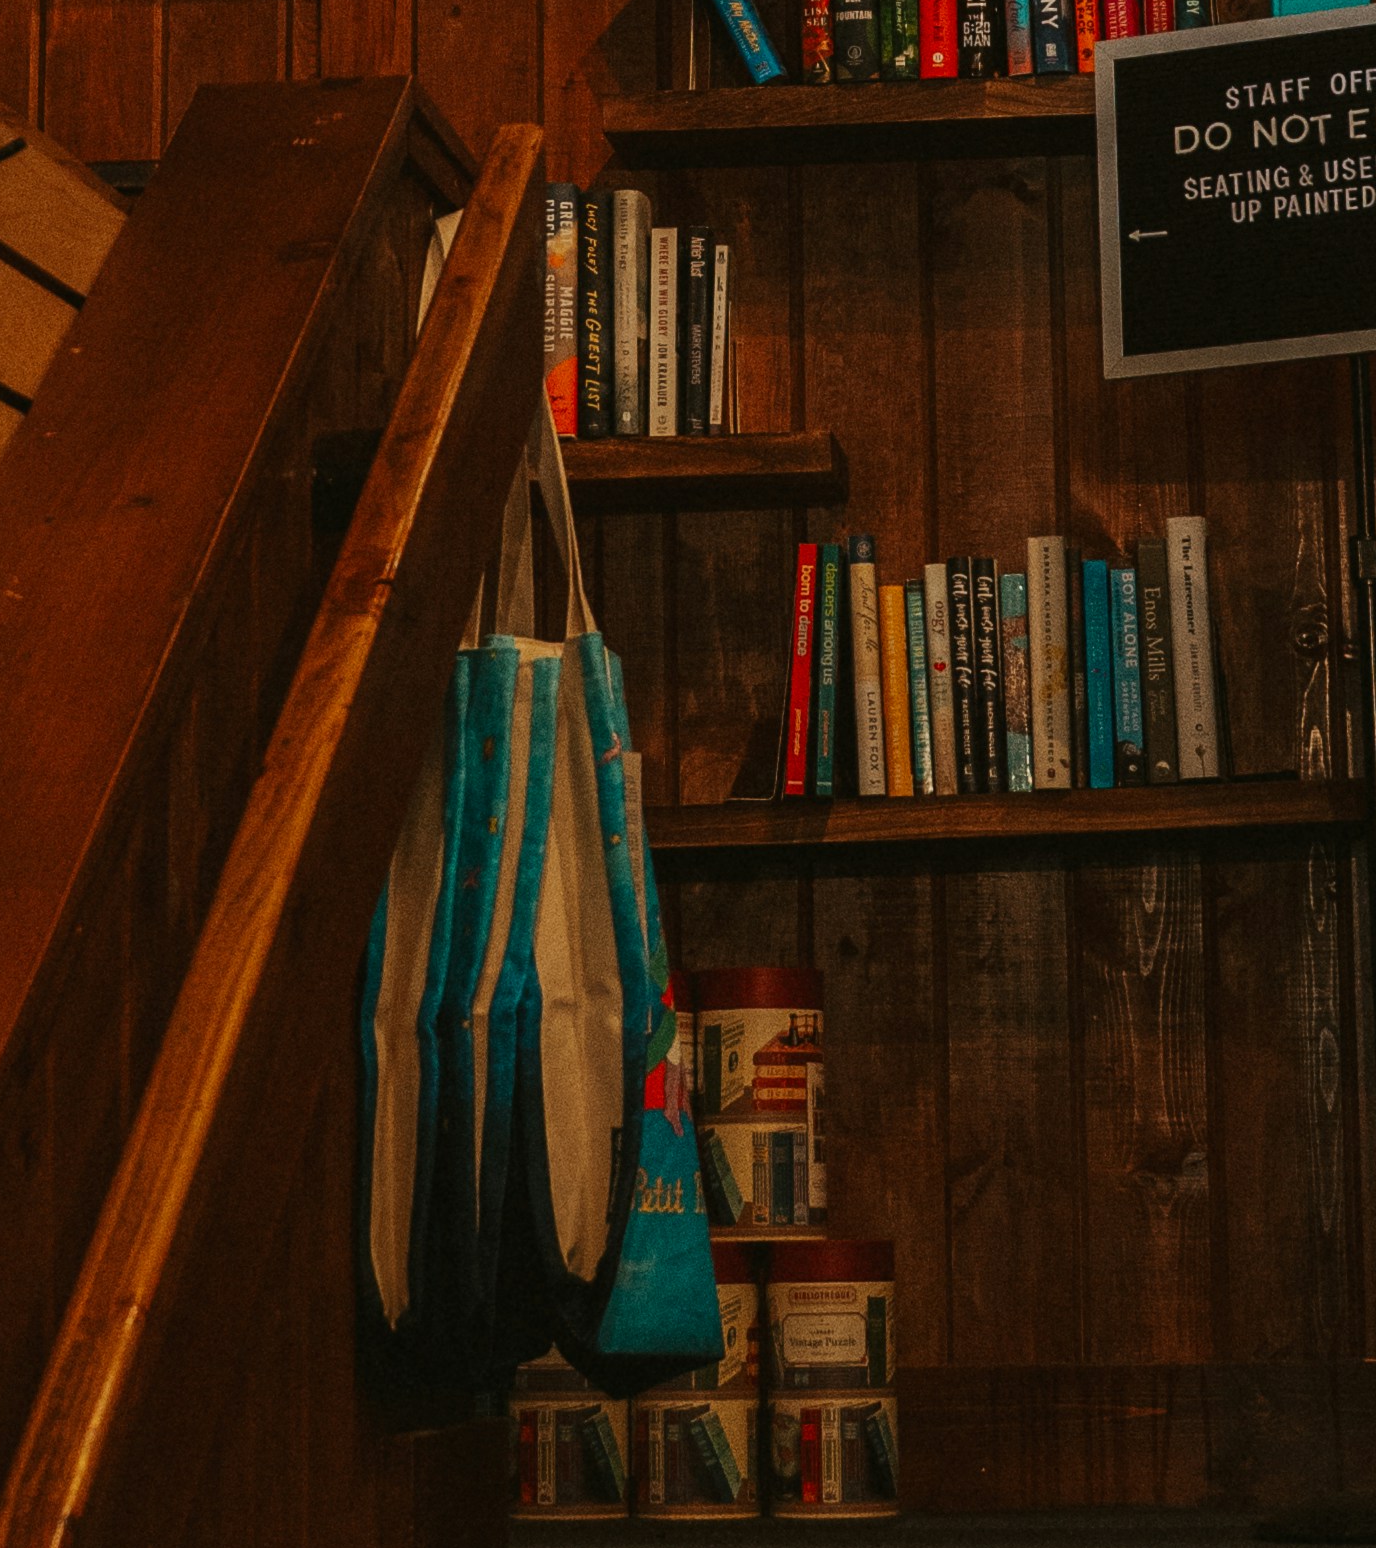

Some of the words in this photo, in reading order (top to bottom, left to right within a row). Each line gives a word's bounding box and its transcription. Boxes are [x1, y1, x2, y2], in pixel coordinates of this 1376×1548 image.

[804, 8, 829, 16] LISA
[836, 10, 872, 19] FOUNTAIN
[963, 22, 990, 33] 6:20
[1086, 20, 1094, 34] OF
[963, 35, 990, 47] MAN
[1226, 77, 1310, 110] STAFF
[1174, 122, 1231, 154] DO
[1253, 114, 1332, 148] NOT
[1183, 166, 1290, 200] SEATING
[1299, 164, 1313, 186] &
[1231, 200, 1261, 223] UP
[1274, 185, 1376, 219] PAINTED
[560, 201, 573, 243] GREAT
[659, 237, 668, 264] WHERE
[659, 269, 668, 286] MEN
[560, 286, 573, 340] MAGGIE
[659, 289, 668, 306] WIN
[659, 309, 667, 336] GLORY
[692, 324, 701, 348] MARK
[658, 343, 667, 359] JON
[691, 351, 701, 384] STEVENS
[657, 363, 666, 406] KRAKAUER
[1181, 536, 1191, 561] The
[801, 564, 814, 595] born
[825, 563, 838, 616] dancers
[1121, 572, 1134, 604] BOY
[800, 600, 812, 613] to
[1143, 587, 1161, 629] Enos
[1183, 565, 1196, 635] Latecomer
[933, 601, 946, 636] oogy
[797, 615, 809, 656] dance
[821, 620, 835, 665] among
[1123, 612, 1137, 668] ALONE
[1147, 636, 1165, 680] Mills
[823, 669, 834, 684] us
[867, 692, 877, 741] LAUREN
[869, 747, 879, 771] FOX
[790, 1338, 822, 1347] Vintage
[826, 1338, 856, 1346] Puzzle
